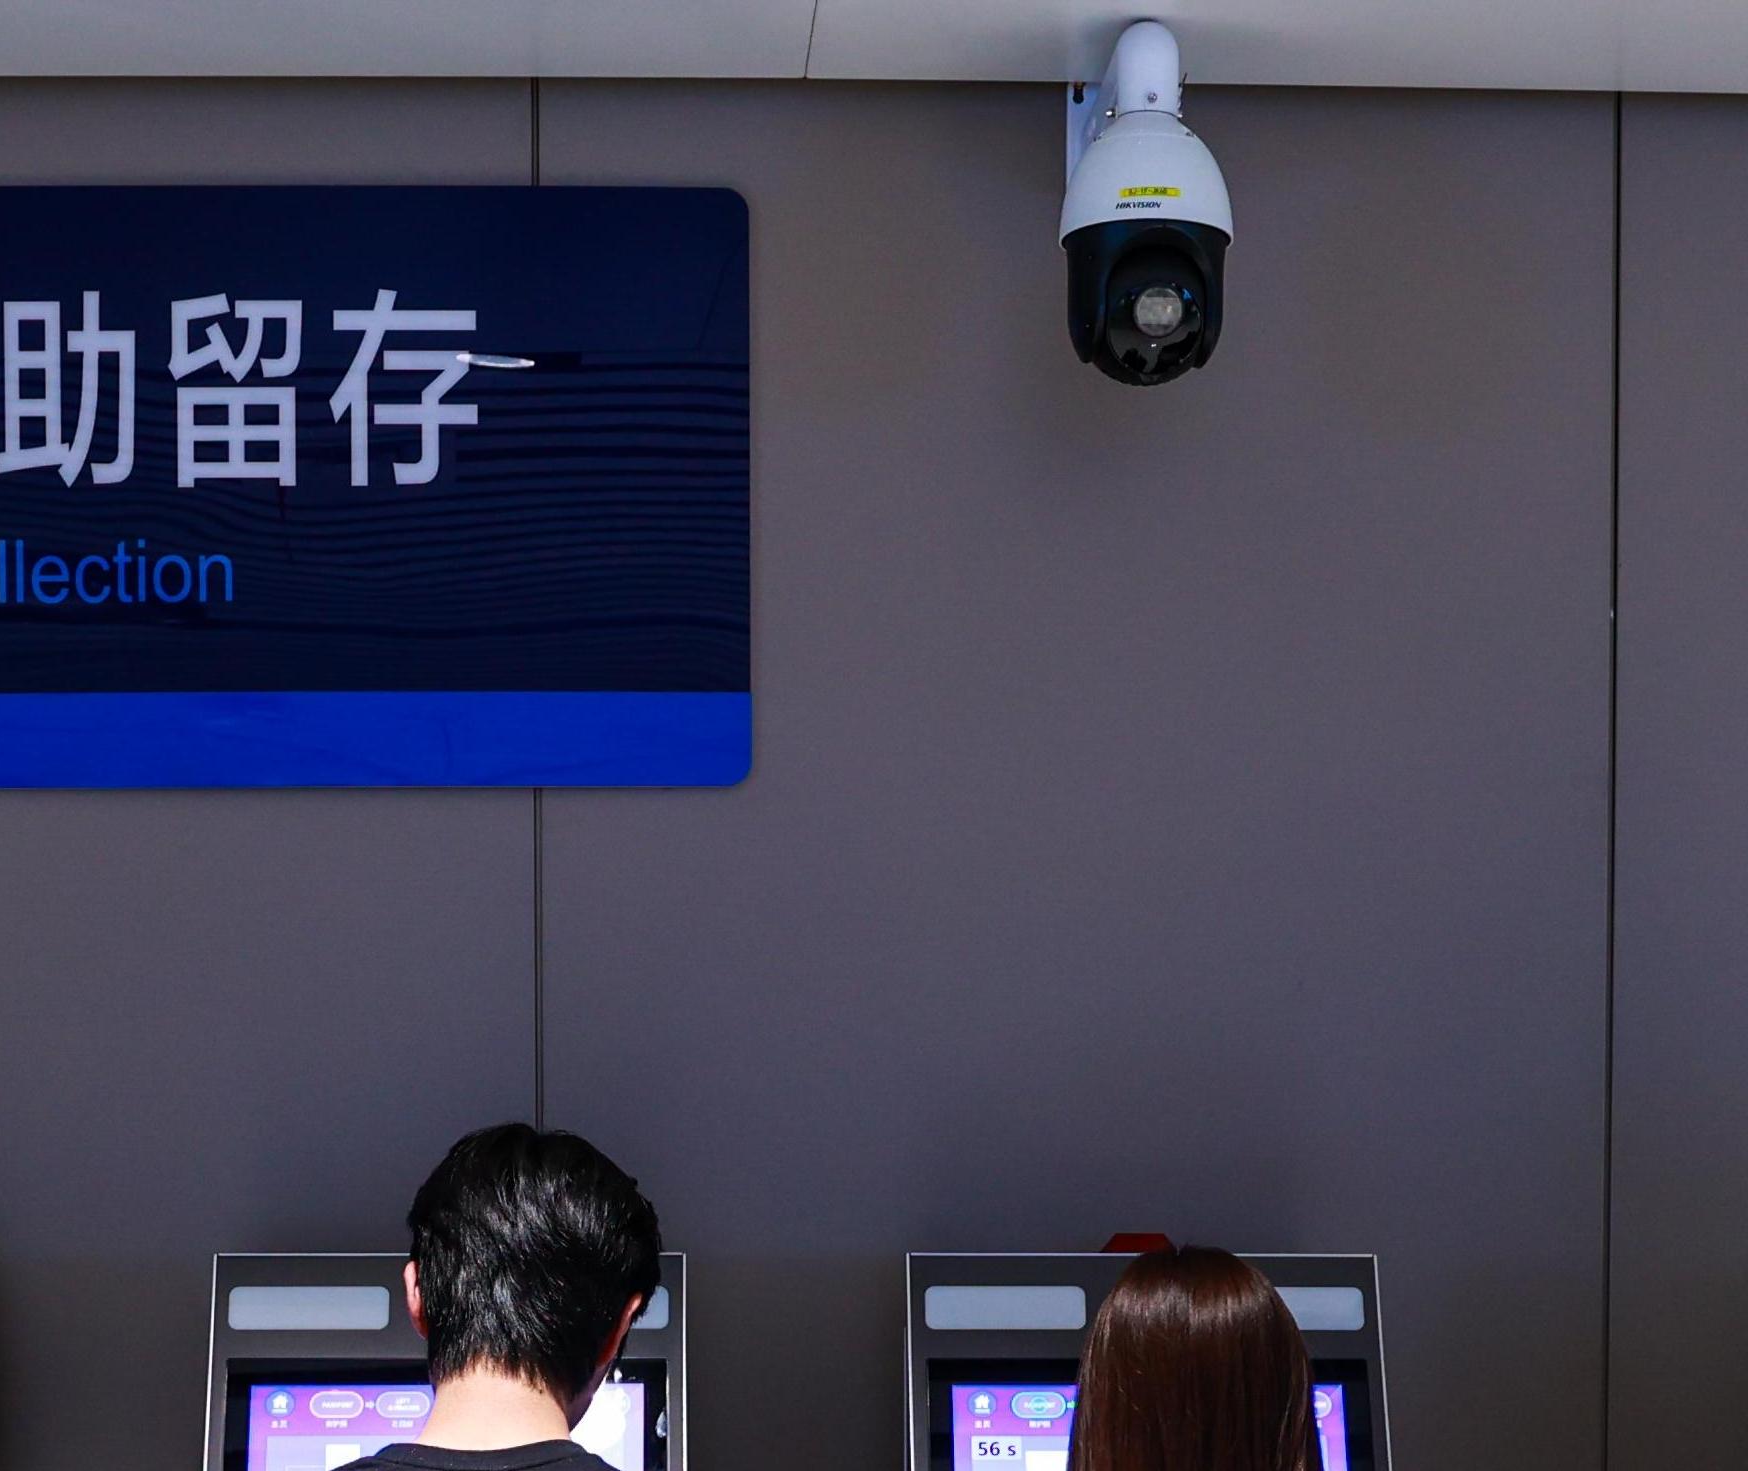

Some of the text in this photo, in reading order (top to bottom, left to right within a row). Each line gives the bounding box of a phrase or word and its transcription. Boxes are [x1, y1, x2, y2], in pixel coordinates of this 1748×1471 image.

[1116, 201, 1161, 209] HIKVISION
[978, 1441, 1016, 1456] 56 s
